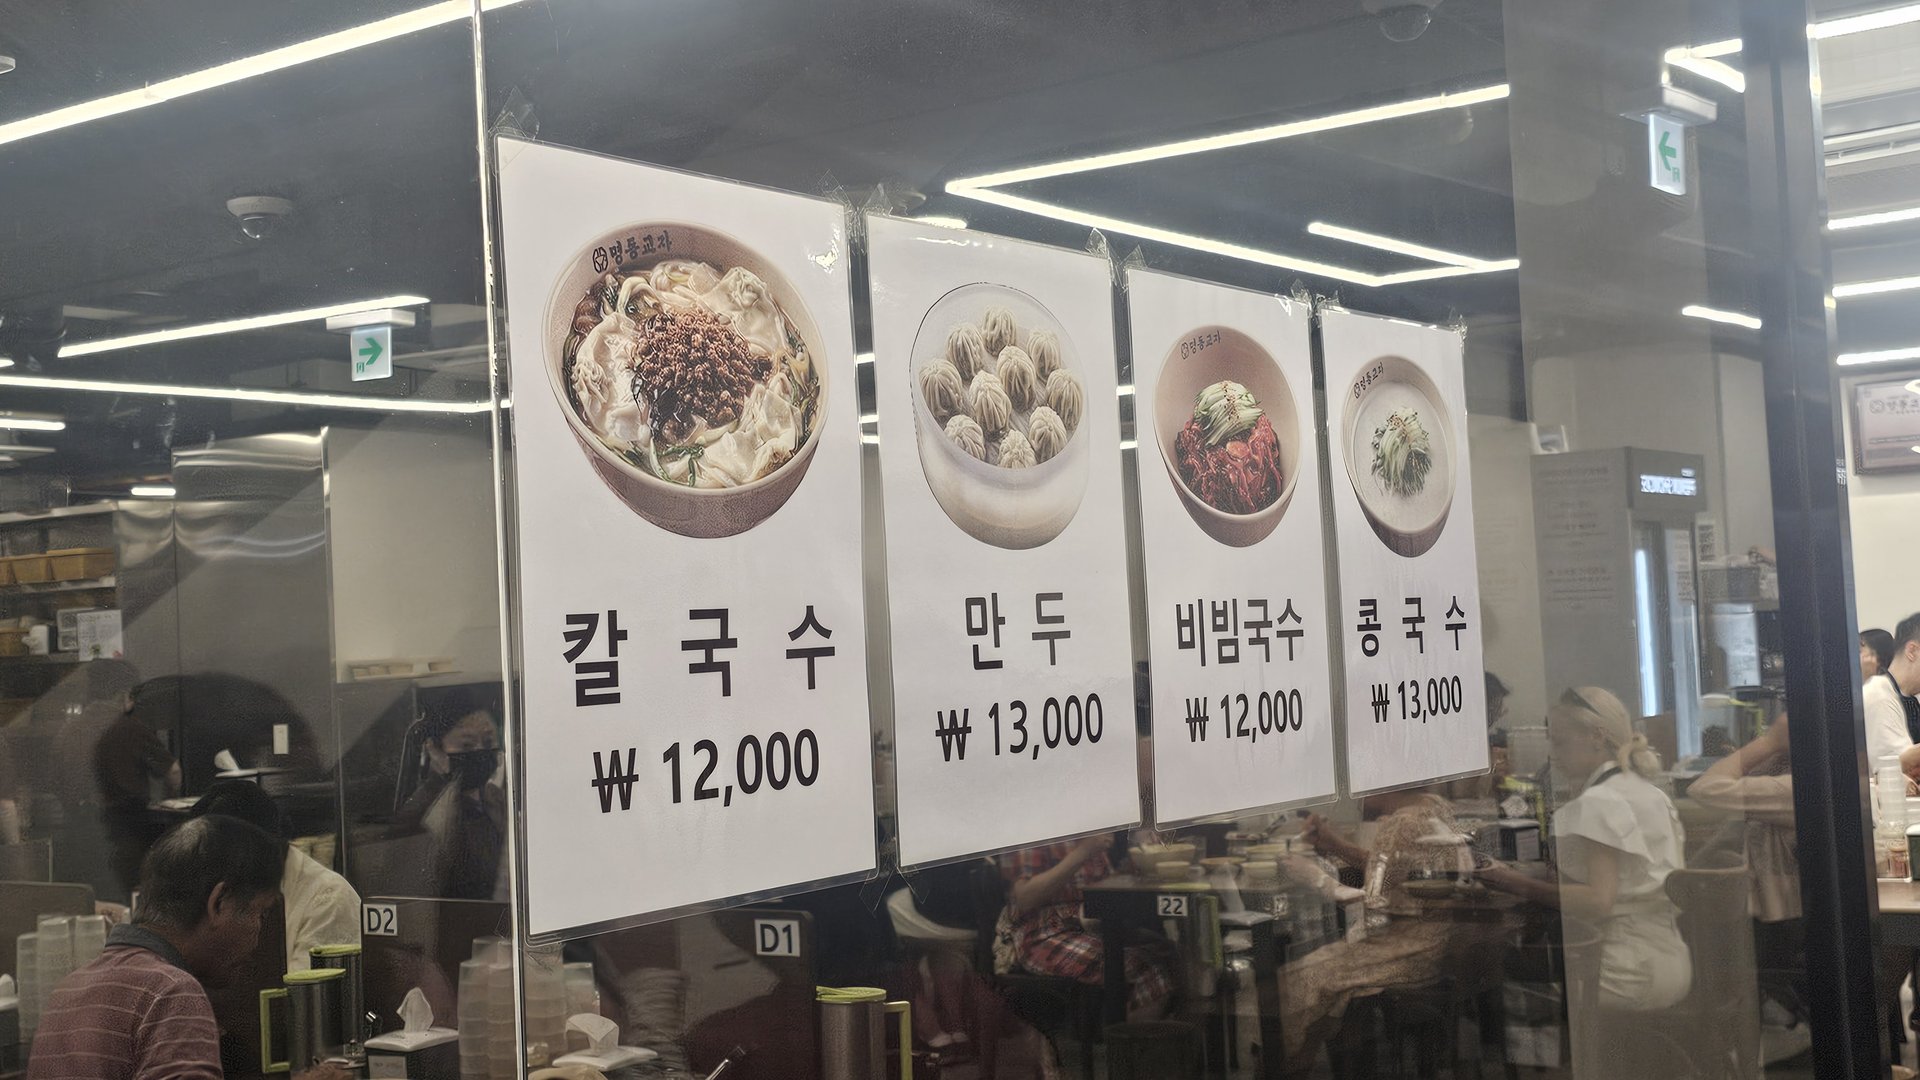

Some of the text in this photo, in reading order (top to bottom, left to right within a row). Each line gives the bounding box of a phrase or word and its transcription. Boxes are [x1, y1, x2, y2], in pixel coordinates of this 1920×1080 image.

[608, 230, 673, 266] 명동교자
[1175, 598, 1304, 667] 비빔국수
[1220, 688, 1303, 743] 12,000
[1397, 675, 1462, 724] 13,000
[988, 692, 1104, 760] 13,000
[662, 728, 820, 807] 12,000
[367, 907, 395, 934] D2
[1162, 898, 1183, 915] 22
[760, 923, 793, 954] D1
